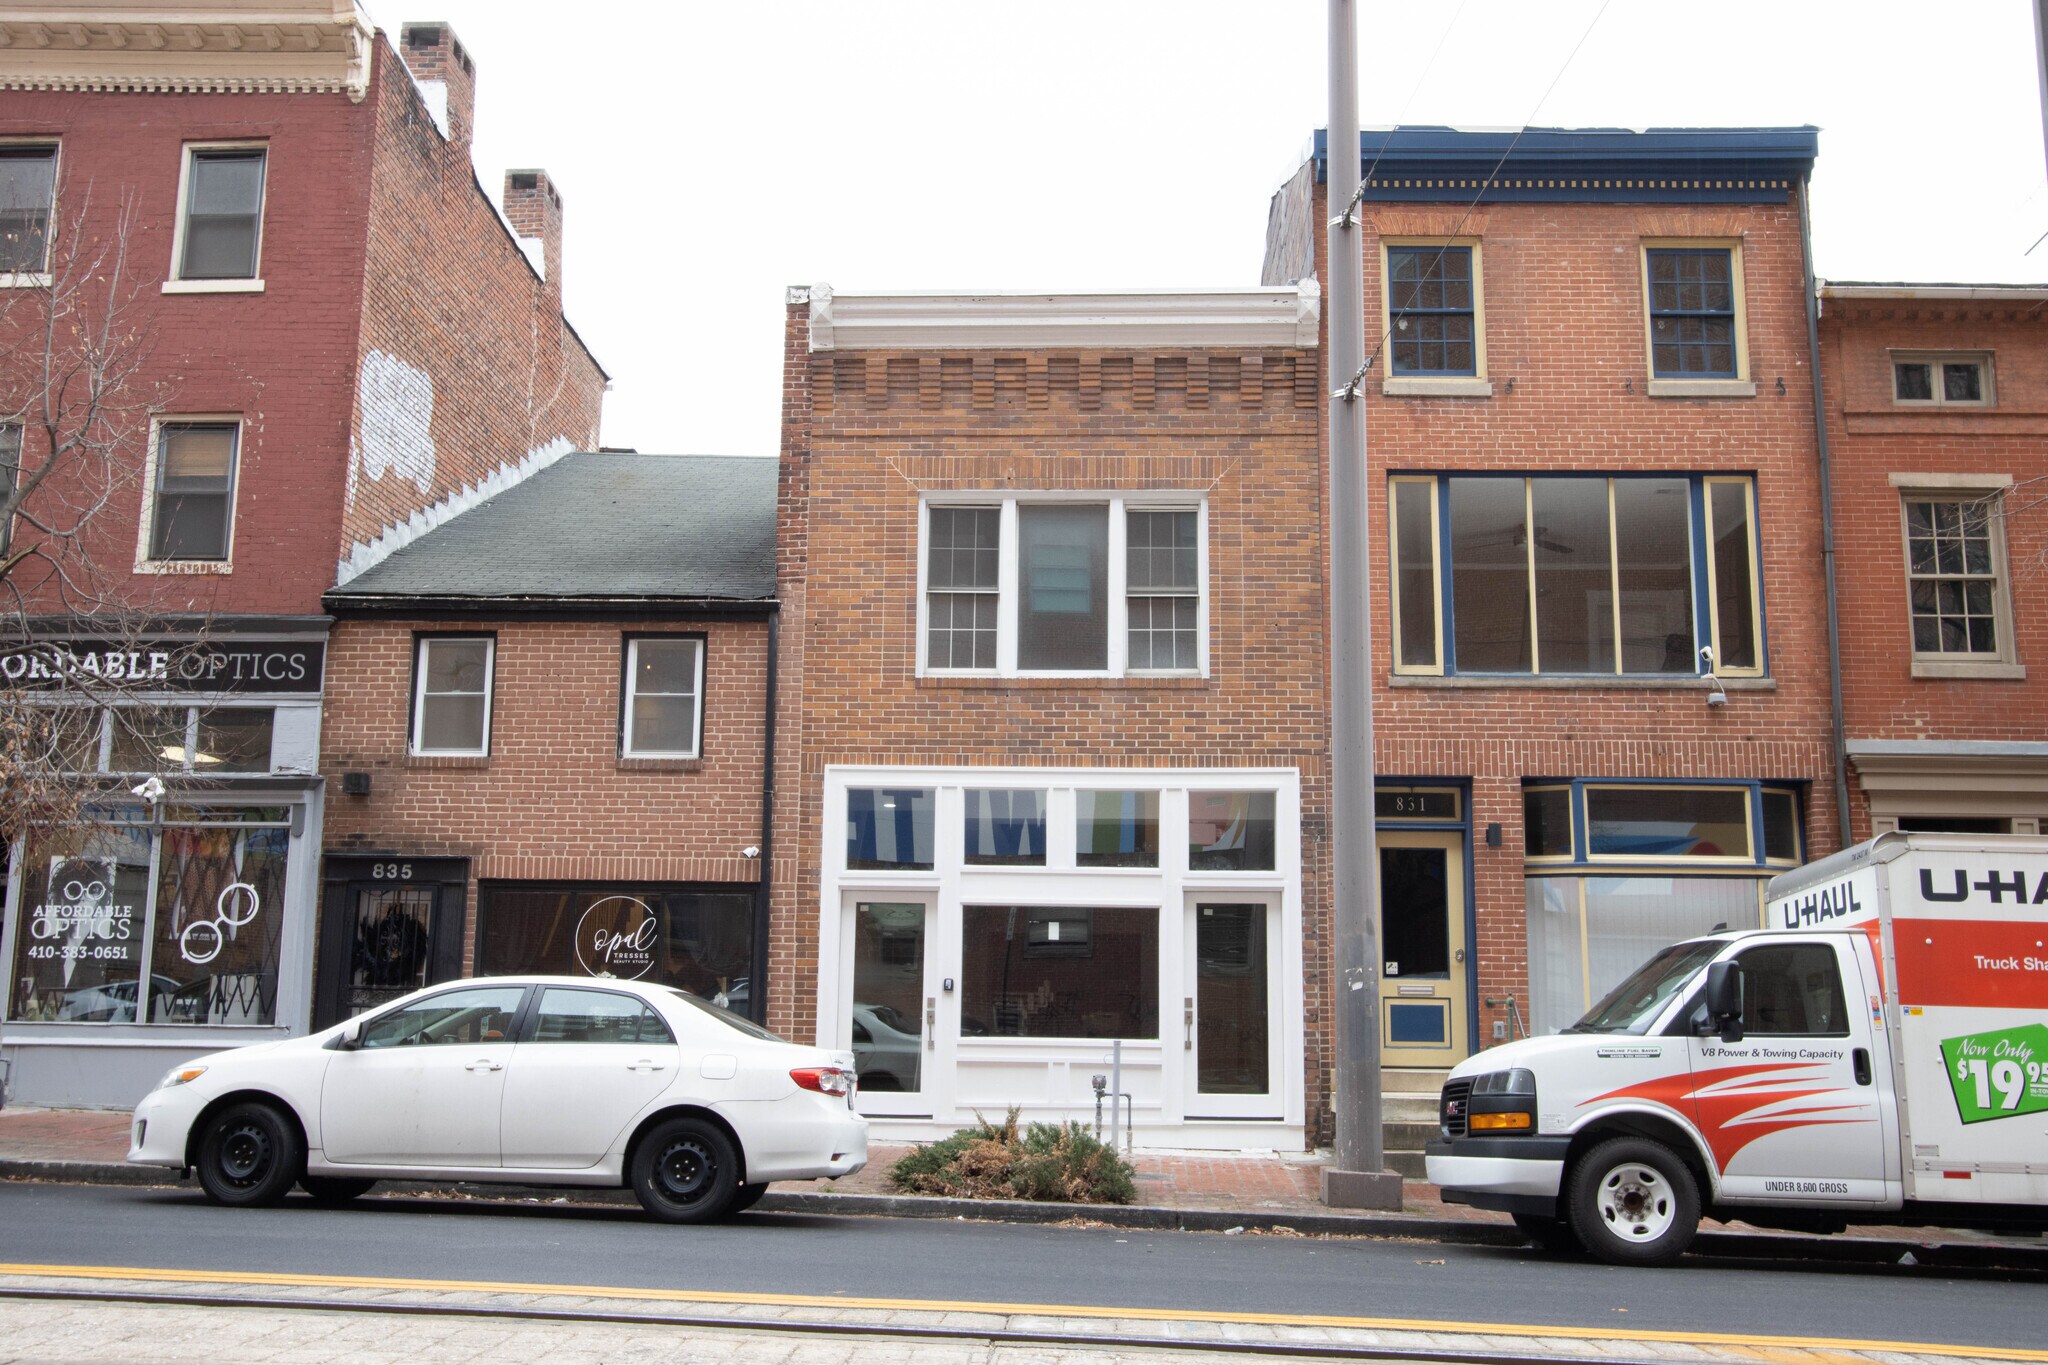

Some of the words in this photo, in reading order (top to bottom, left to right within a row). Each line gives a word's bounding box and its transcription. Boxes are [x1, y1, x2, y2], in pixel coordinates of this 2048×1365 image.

[178, 653, 305, 680] OPTICS
[1396, 796, 1425, 811] 831
[372, 863, 412, 879] 835
[33, 905, 132, 918] AFFORDABLE
[1784, 880, 1861, 929] U-HAUL
[31, 917, 131, 940] OPTICS
[594, 917, 658, 963] opal
[28, 945, 128, 959] 410-383-0651
[1973, 955, 2020, 970] Truck
[1701, 1047, 1716, 1057] V8
[1717, 1048, 1749, 1057] Power
[1751, 1048, 1760, 1058] &
[1762, 1049, 1797, 1059] Towing
[1799, 1049, 1844, 1060] Capacity
[1957, 1038, 1990, 1056] Now
[1993, 1039, 2033, 1064] Only
[1765, 1181, 1795, 1192] UNDER
[1796, 1183, 1817, 1193] 8,600
[1818, 1183, 1848, 1193] GROSS
